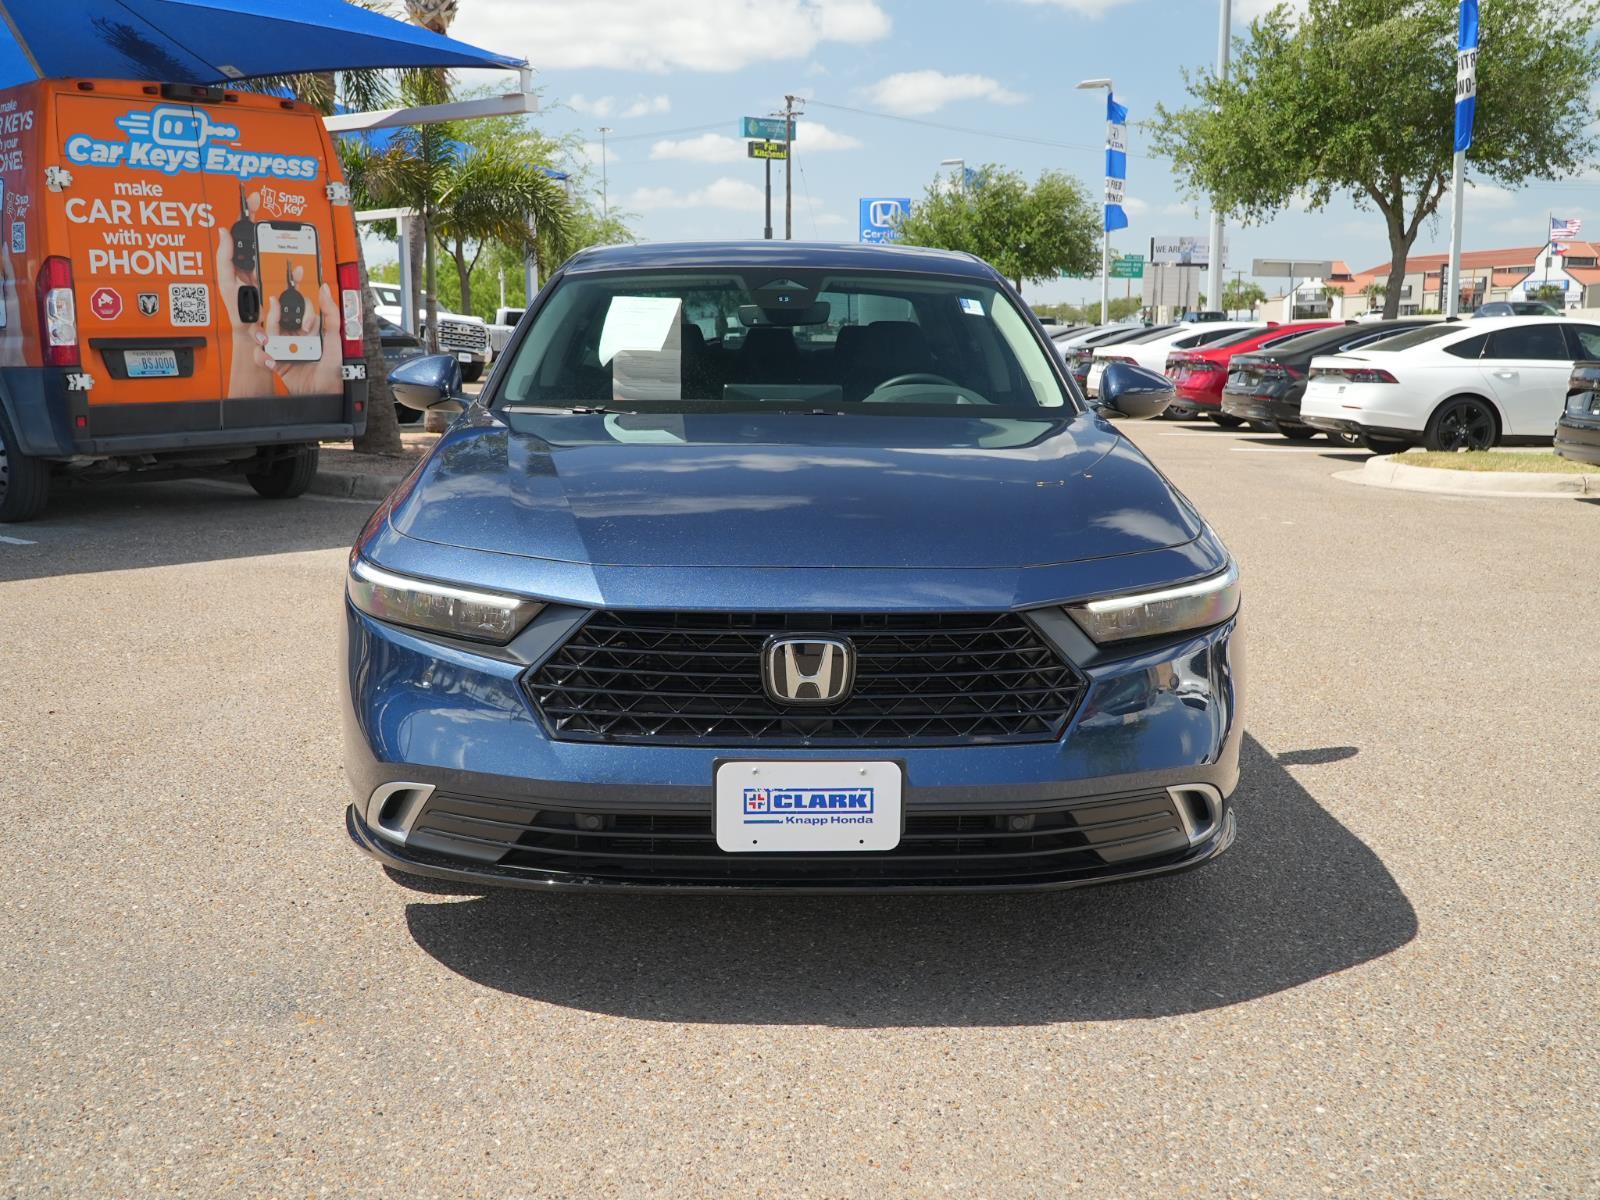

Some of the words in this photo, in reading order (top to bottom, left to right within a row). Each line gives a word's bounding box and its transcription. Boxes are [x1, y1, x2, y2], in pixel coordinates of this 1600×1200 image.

[4, 110, 34, 134] KEYS
[68, 137, 124, 163] Car
[129, 142, 200, 172] Keys
[205, 148, 315, 177] Express
[113, 180, 164, 197] make
[279, 192, 305, 205] Snap
[65, 198, 133, 224] CAR
[139, 200, 216, 228] KEYS
[283, 203, 305, 217] Key
[103, 229, 143, 246] with
[146, 233, 186, 249] your
[1168, 246, 1181, 254] ARE
[88, 248, 204, 276] PHONE!
[773, 793, 868, 809] CLARK
[785, 816, 828, 826] Knapp
[831, 815, 873, 824] Honda
